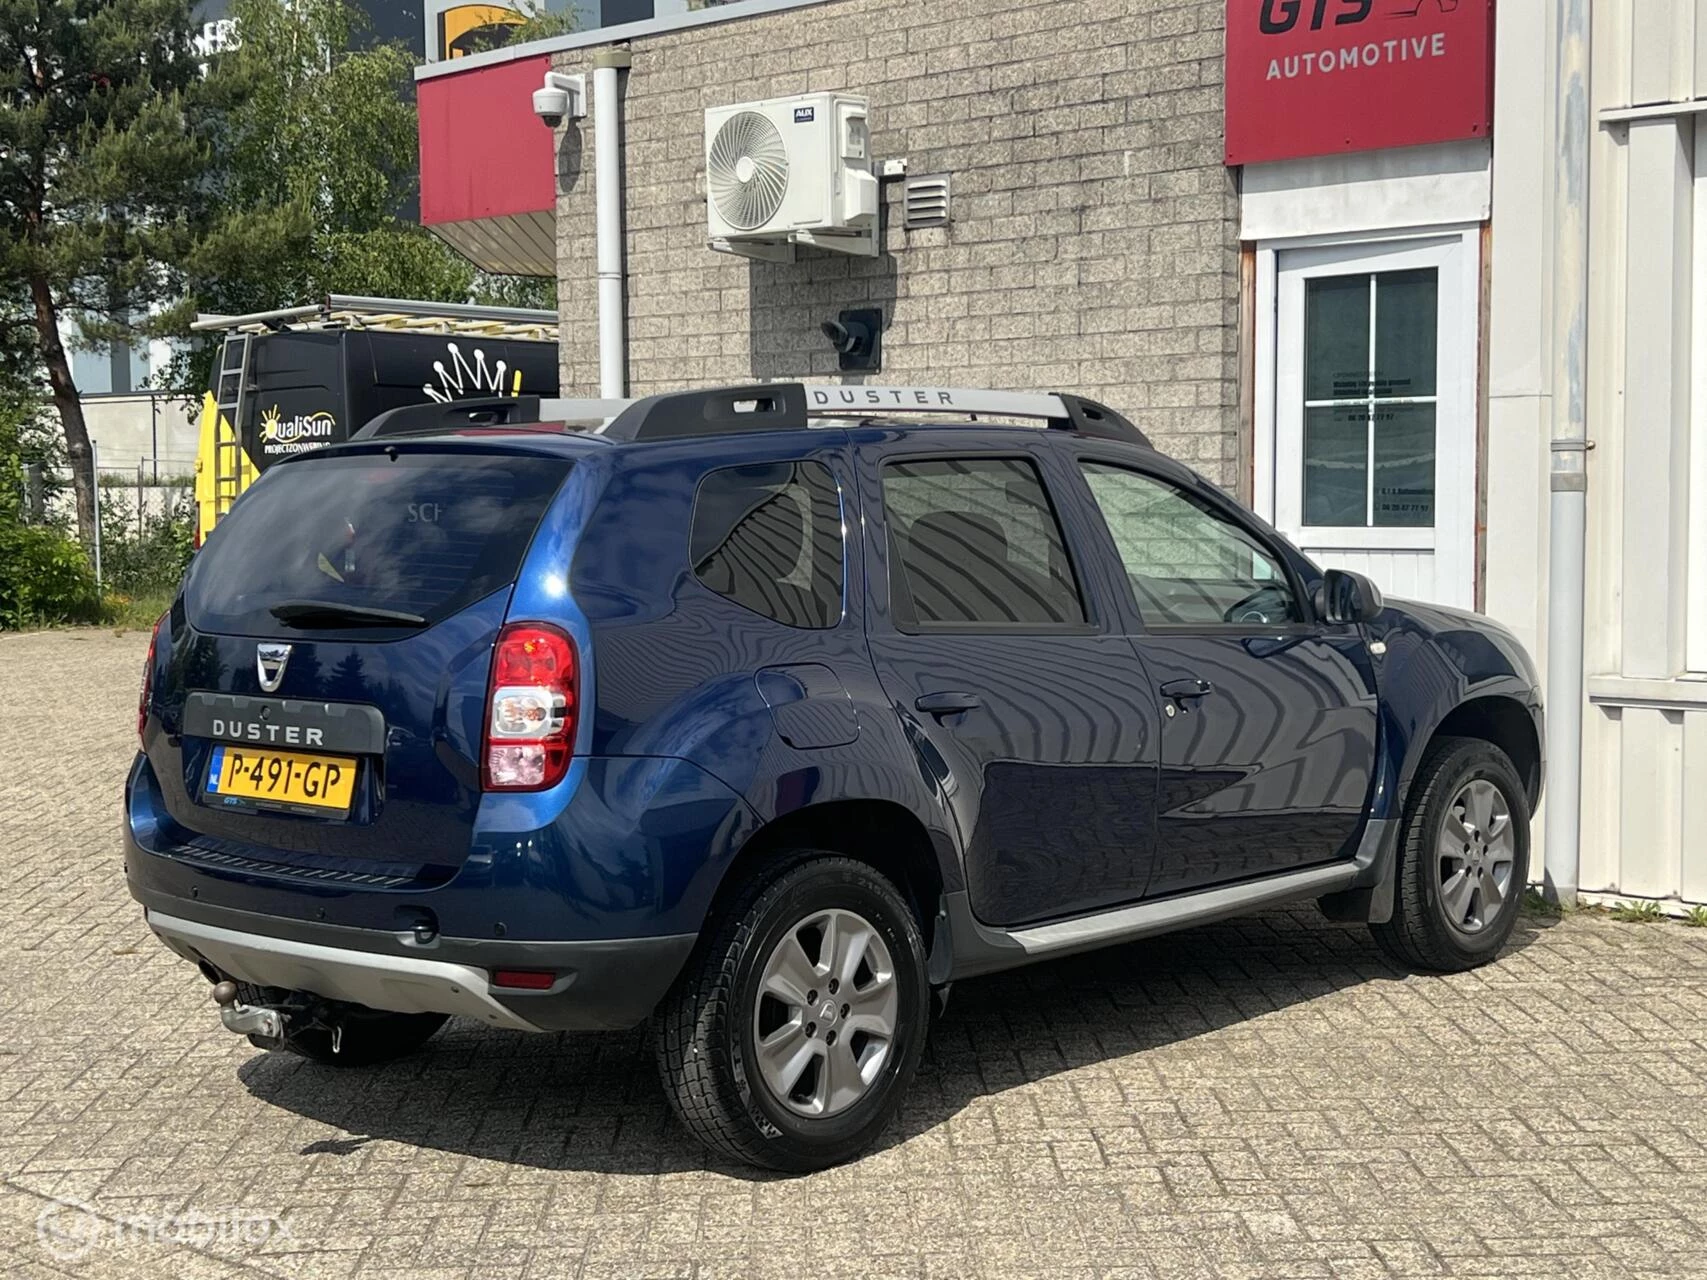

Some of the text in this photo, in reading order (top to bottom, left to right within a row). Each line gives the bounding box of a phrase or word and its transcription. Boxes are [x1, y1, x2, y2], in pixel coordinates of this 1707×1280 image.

[1266, 32, 1446, 81] AUTOMOTIVE
[795, 108, 813, 118] AUX
[813, 390, 953, 405] DUSTER
[260, 405, 335, 443] QualiSun
[212, 719, 324, 746] DUSTER
[228, 753, 341, 799] P-491-GP
